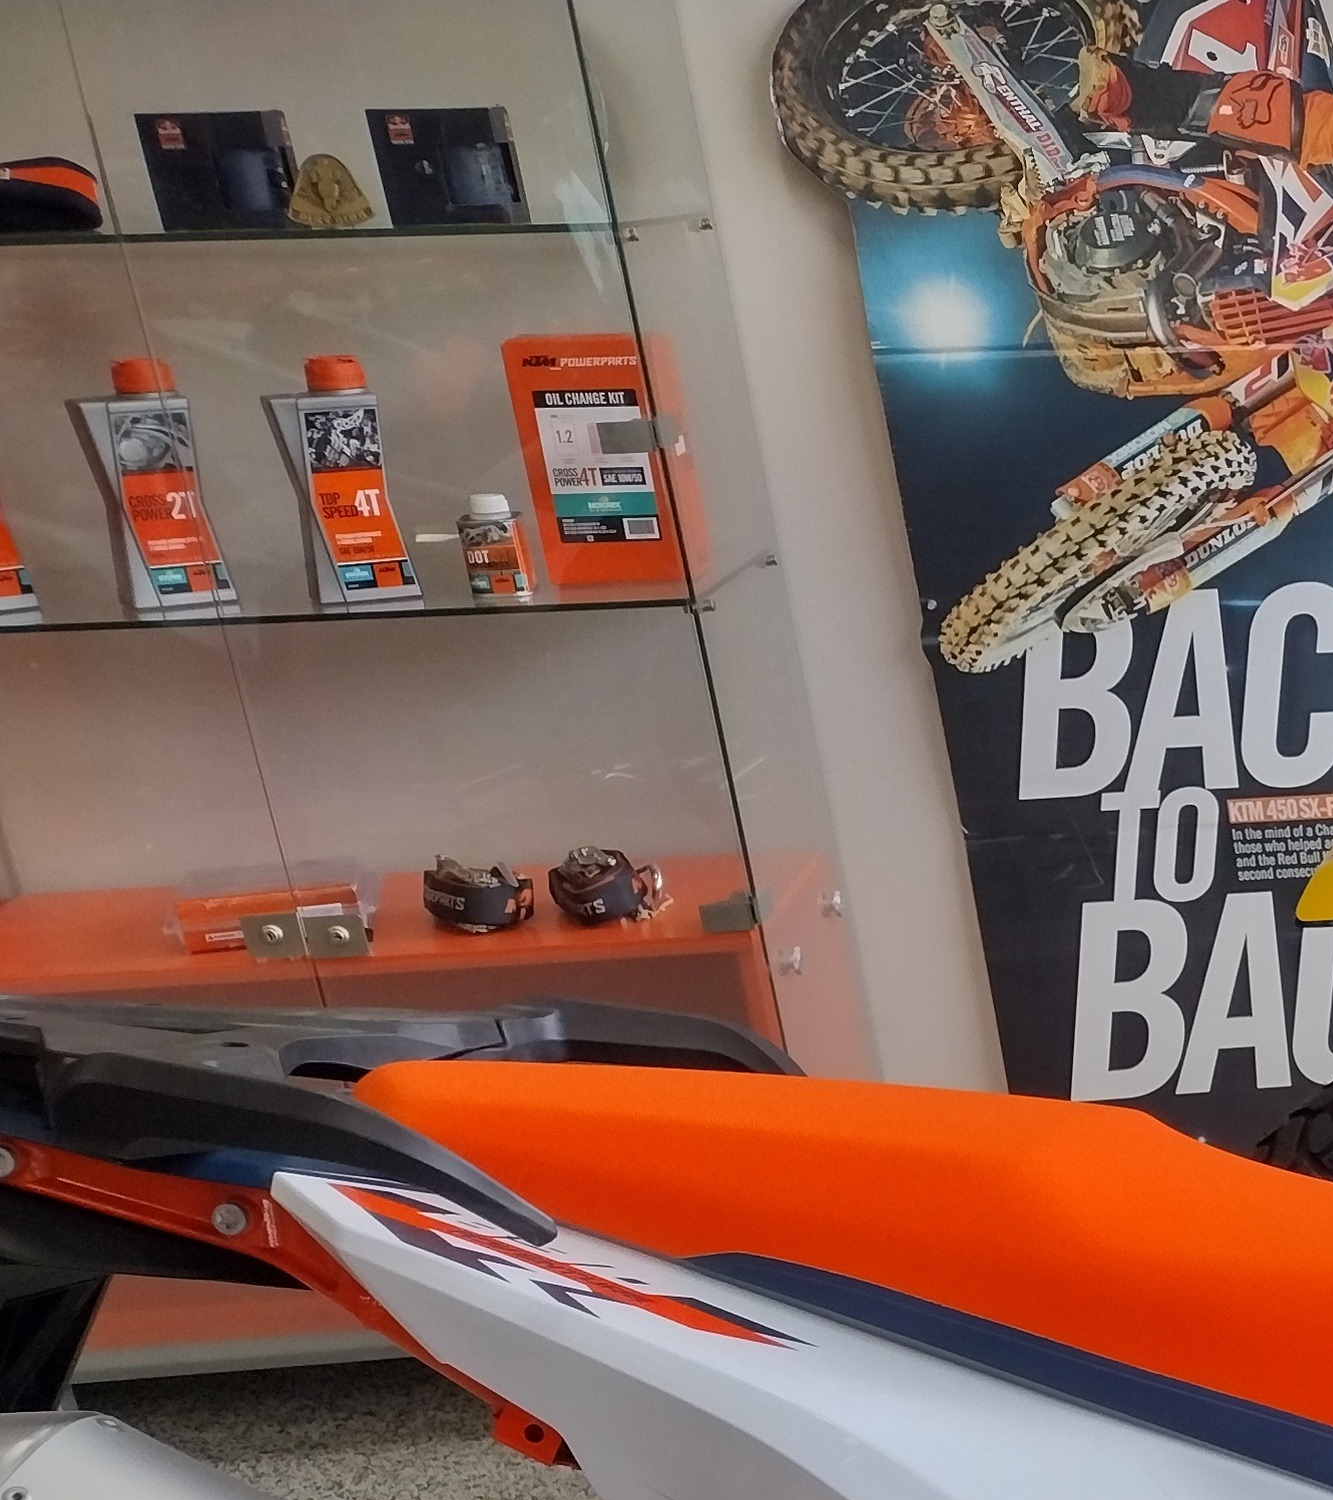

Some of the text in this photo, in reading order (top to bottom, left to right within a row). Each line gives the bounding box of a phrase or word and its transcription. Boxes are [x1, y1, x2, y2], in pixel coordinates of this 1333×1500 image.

[560, 355, 638, 368] POWERPARTS
[545, 391, 625, 405] OIL CHANGE KIT
[556, 430, 574, 444] 1.2
[1121, 418, 1204, 480] DULOP
[552, 467, 579, 476] CROSS
[554, 477, 582, 487] POWER
[319, 492, 341, 505] TOP
[323, 488, 381, 519] SPEED 4T
[466, 550, 490, 564] DOT
[1229, 800, 1264, 823] KTM
[1266, 799, 1296, 820] 450
[1232, 828, 1243, 841] In
[1244, 827, 1263, 840] the
[1264, 826, 1291, 839] mind
[1292, 825, 1305, 838] of
[1306, 827, 1313, 837] a
[1100, 785, 1220, 903] TO
[1233, 842, 1263, 855] those
[1264, 841, 1286, 853] who
[1287, 839, 1323, 853] helped
[1236, 851, 1321, 868] and the Red Bull
[1238, 868, 1274, 881] second
